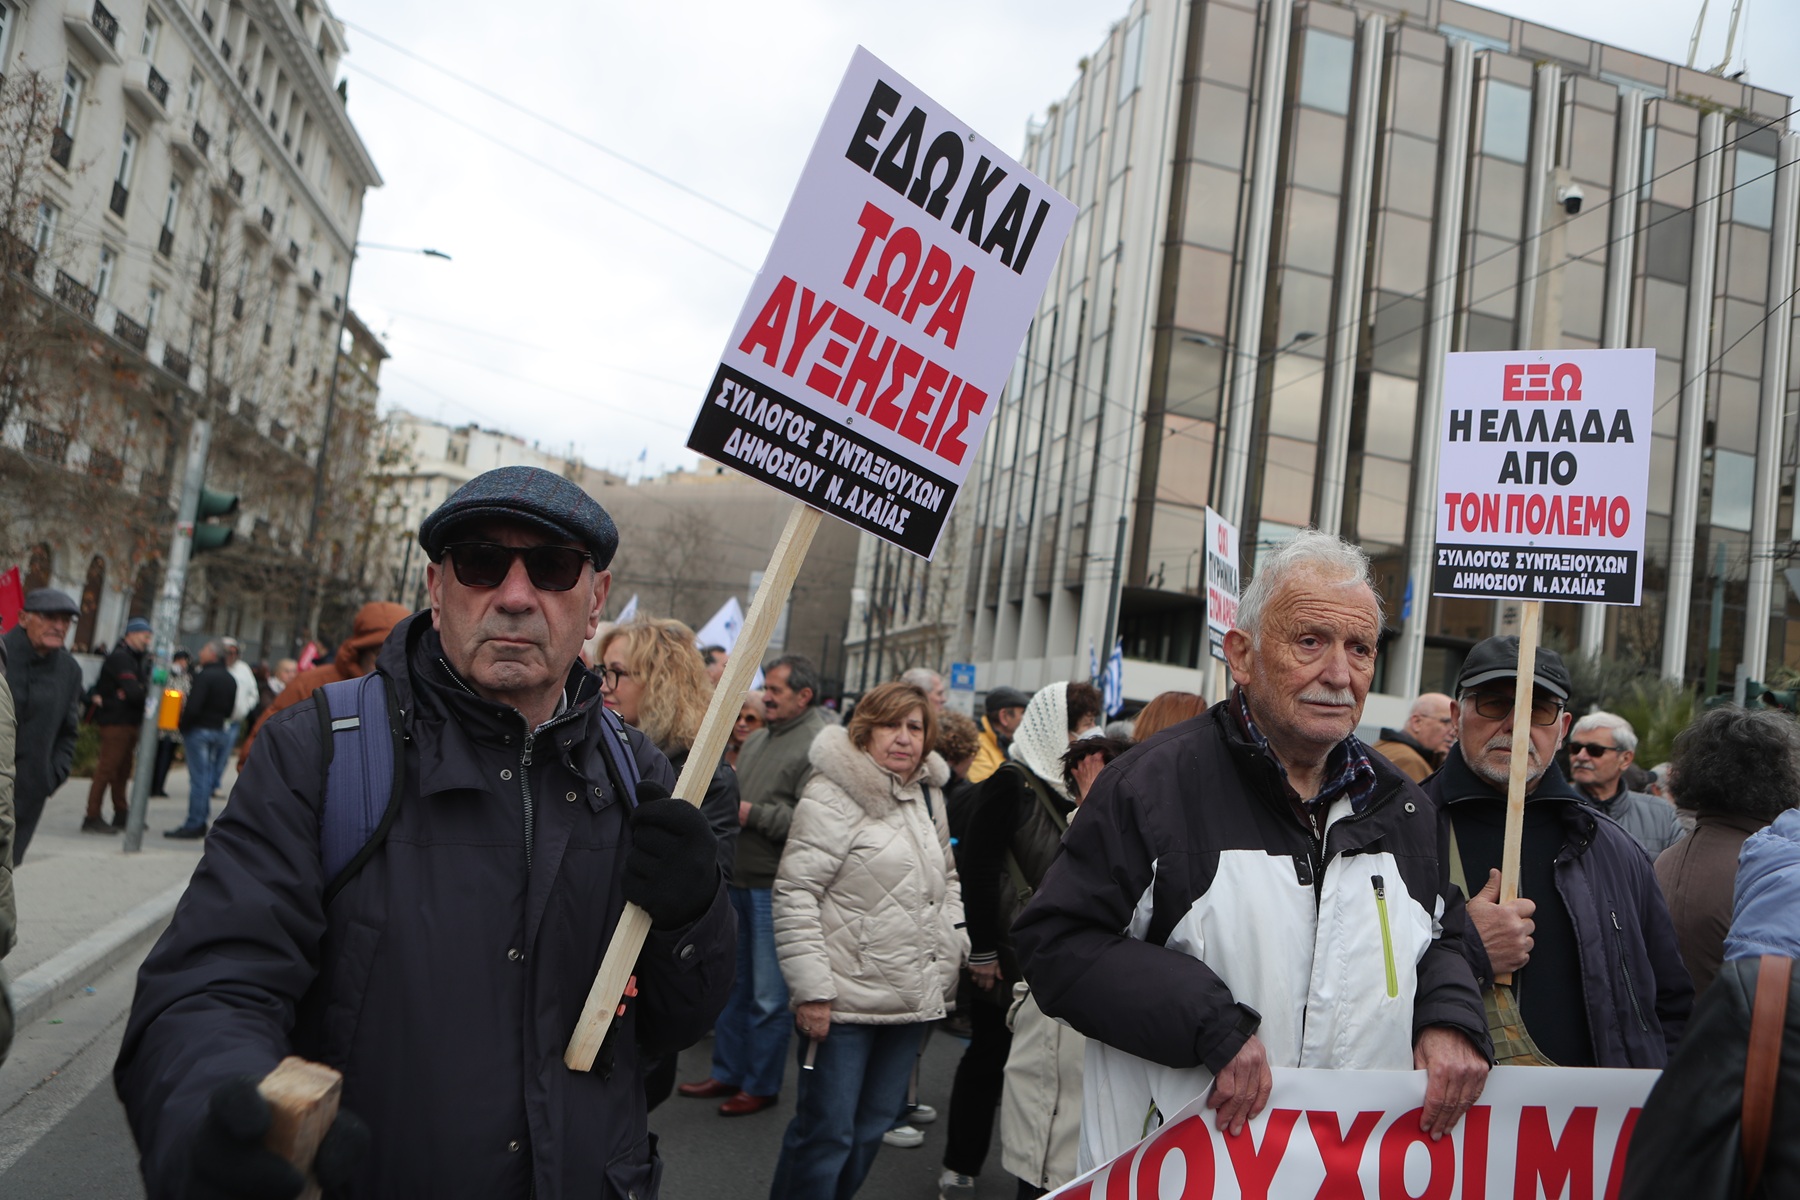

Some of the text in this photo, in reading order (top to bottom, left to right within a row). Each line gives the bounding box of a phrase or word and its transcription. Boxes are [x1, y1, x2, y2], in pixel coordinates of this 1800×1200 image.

[845, 78, 1051, 275] ΕΔΩ ΚΑΙ
[842, 200, 976, 350] ΤΩΡΑ
[738, 275, 989, 466] ΑΥΞΗΣΕΙΣ
[1502, 362, 1583, 402] ΕΞΩ
[714, 377, 946, 513] ΣΥΛΛΟΓΟΣ ΣΥΝΤΑΞΙΟΥΧΩΝ
[1448, 408, 1635, 444] Η ΕΛΛΑΔΑ
[722, 426, 826, 493] ΔΗΜΟΣΙΟΥ
[1497, 450, 1578, 486] ΑΠΟ
[1444, 491, 1631, 539] ΤΟΝ ΠΟΛΕΜΟ
[1437, 549, 1628, 574] ΣΥΛΛΟΓΟΣ ΣΥΝΤΑΞΙΟΥΧΩΝ
[1452, 571, 1528, 593] ΔΗΜΟΣΙΟΥ
